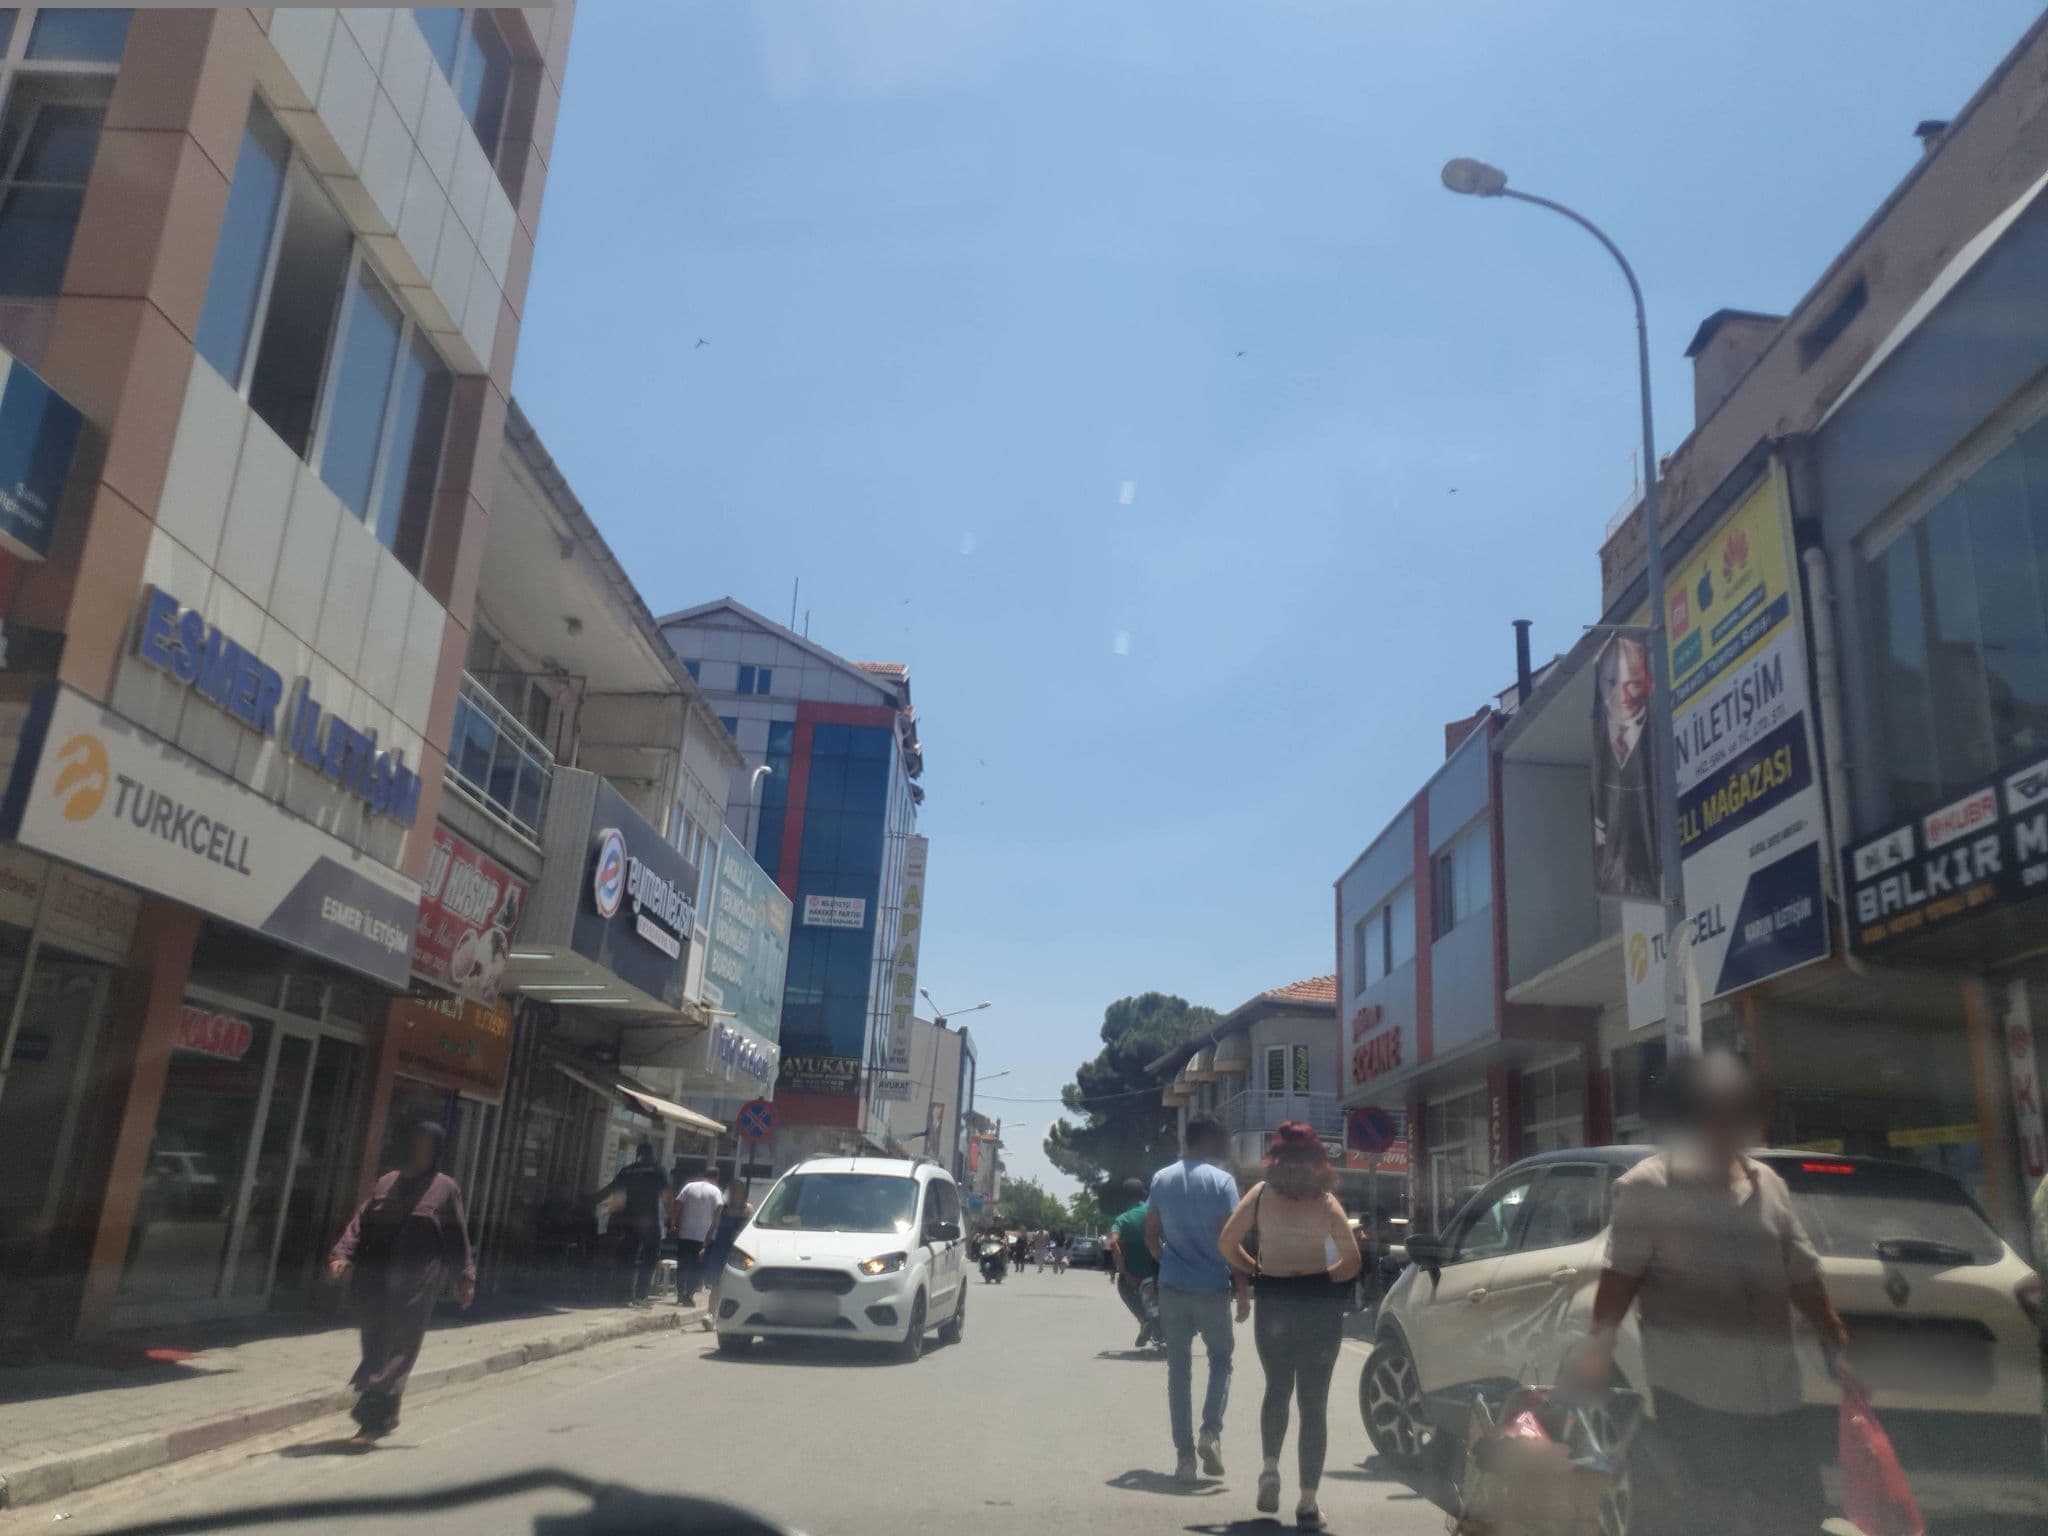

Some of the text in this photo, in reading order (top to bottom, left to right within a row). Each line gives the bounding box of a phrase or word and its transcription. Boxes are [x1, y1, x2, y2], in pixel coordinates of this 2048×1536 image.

[139, 584, 283, 738] ESMER
[1692, 653, 1784, 756] İLETİŞİM
[114, 774, 251, 877] TURKCELL
[1702, 745, 1793, 831] MAĞAZASI
[320, 895, 364, 933] ESMER
[361, 907, 409, 953] İLETİŞİM
[1856, 834, 2003, 924] BALKIR
[893, 884, 922, 1030] APART
[783, 1056, 859, 1074] AVUKAT
[878, 1080, 910, 1090] AVUKAT
